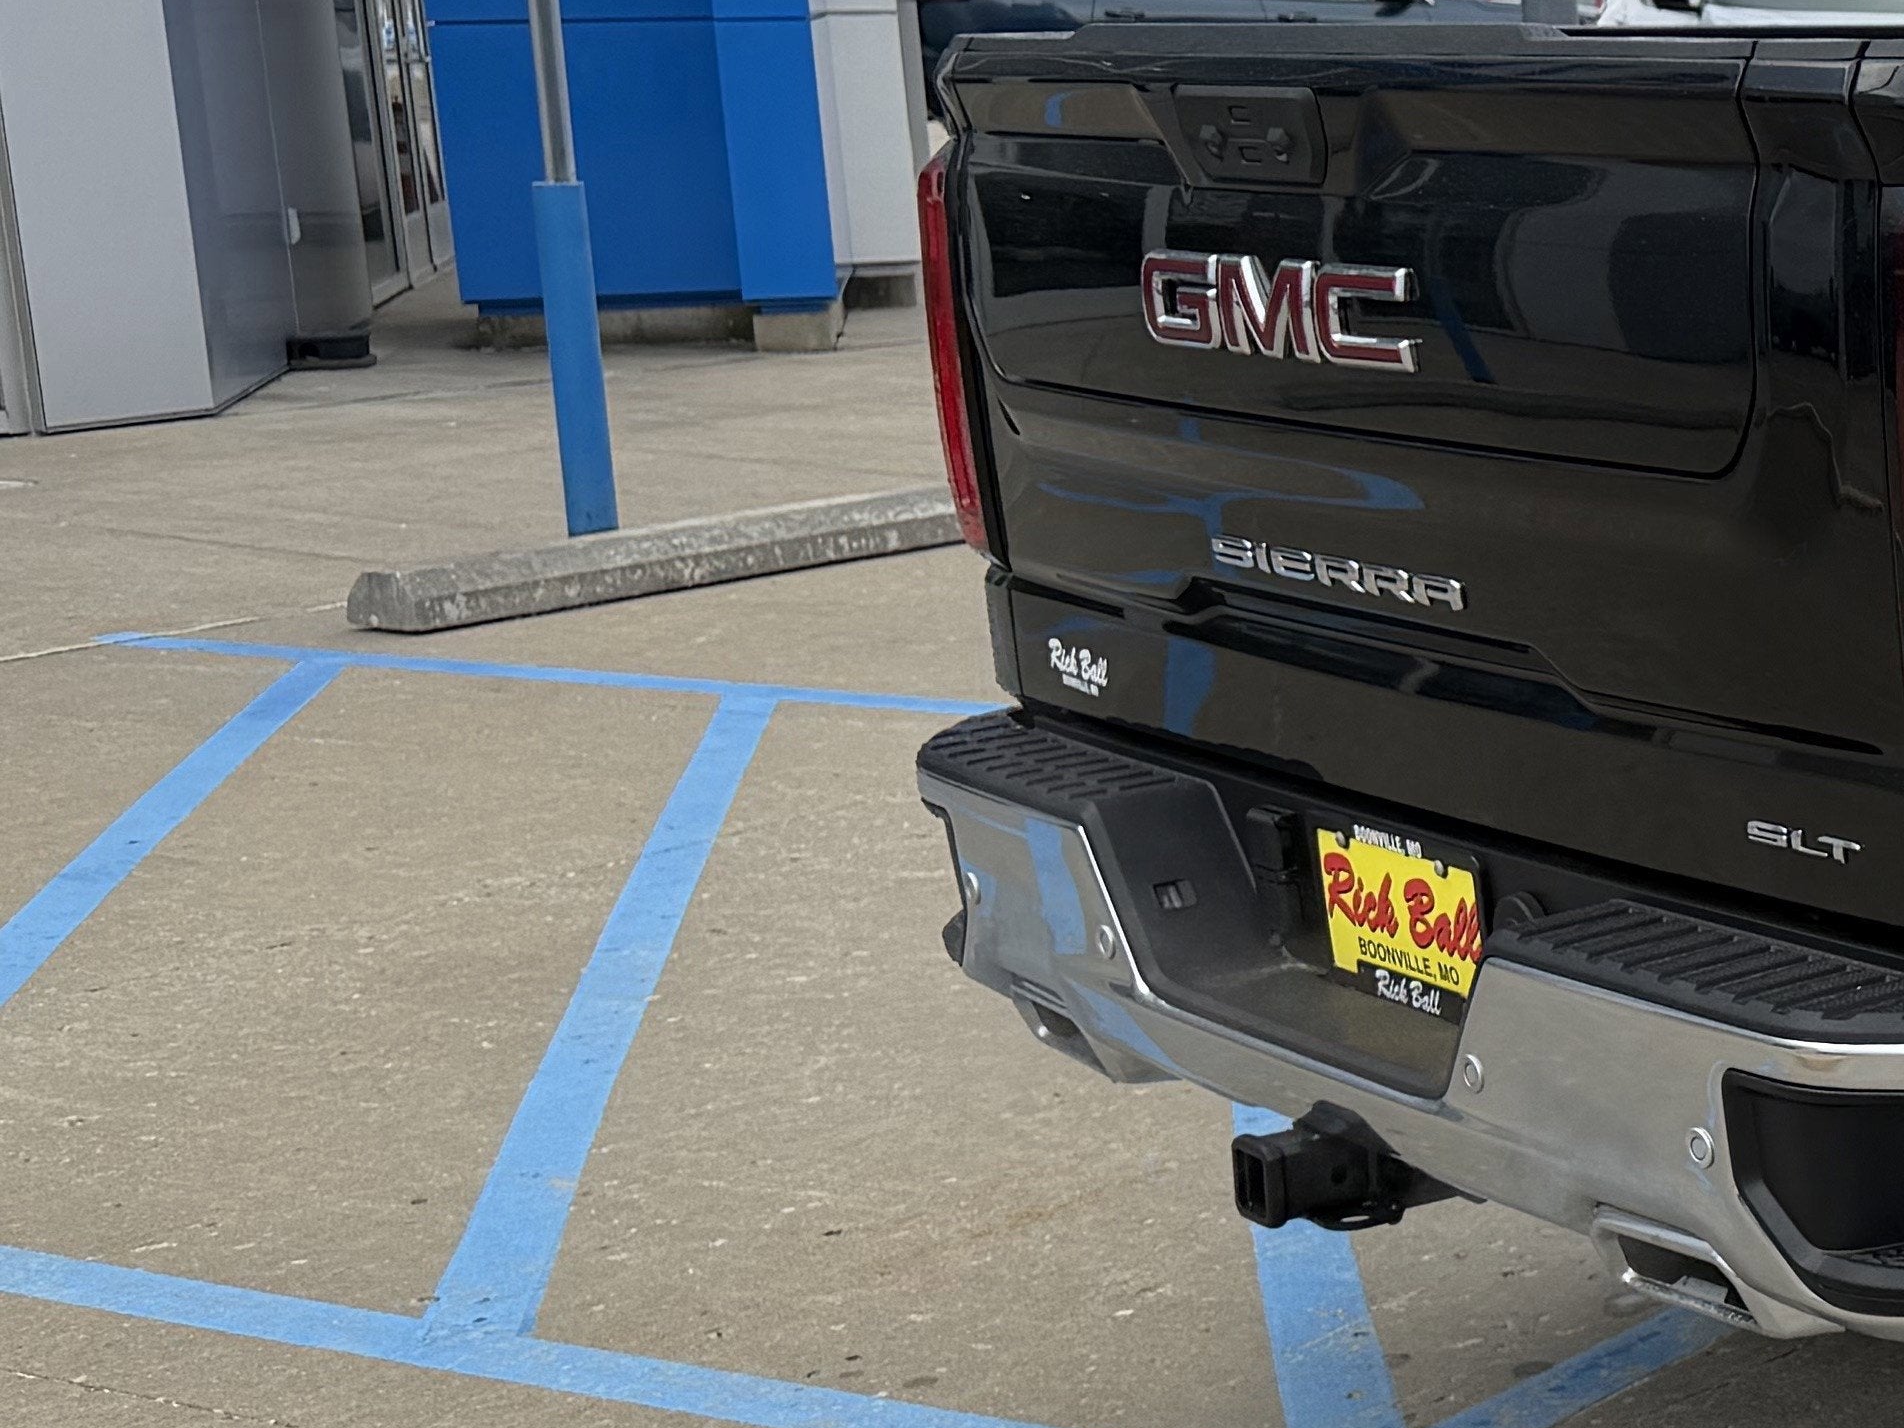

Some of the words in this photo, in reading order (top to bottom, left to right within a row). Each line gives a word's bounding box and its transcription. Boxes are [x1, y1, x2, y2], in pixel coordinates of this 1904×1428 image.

[1141, 251, 1421, 373] GMC
[1211, 534, 1467, 612] SIERRA
[1048, 637, 1078, 676] Rick
[1079, 648, 1108, 687] Ball
[1405, 839, 1423, 859] MO
[1747, 820, 1862, 865] SLT
[1323, 852, 1399, 938] Rick
[1403, 878, 1483, 964] Ball
[1358, 936, 1436, 982] BOONVILLE,
[1437, 962, 1460, 986] MO
[1375, 969, 1409, 1004] Rick
[1409, 980, 1441, 1015] Ball
